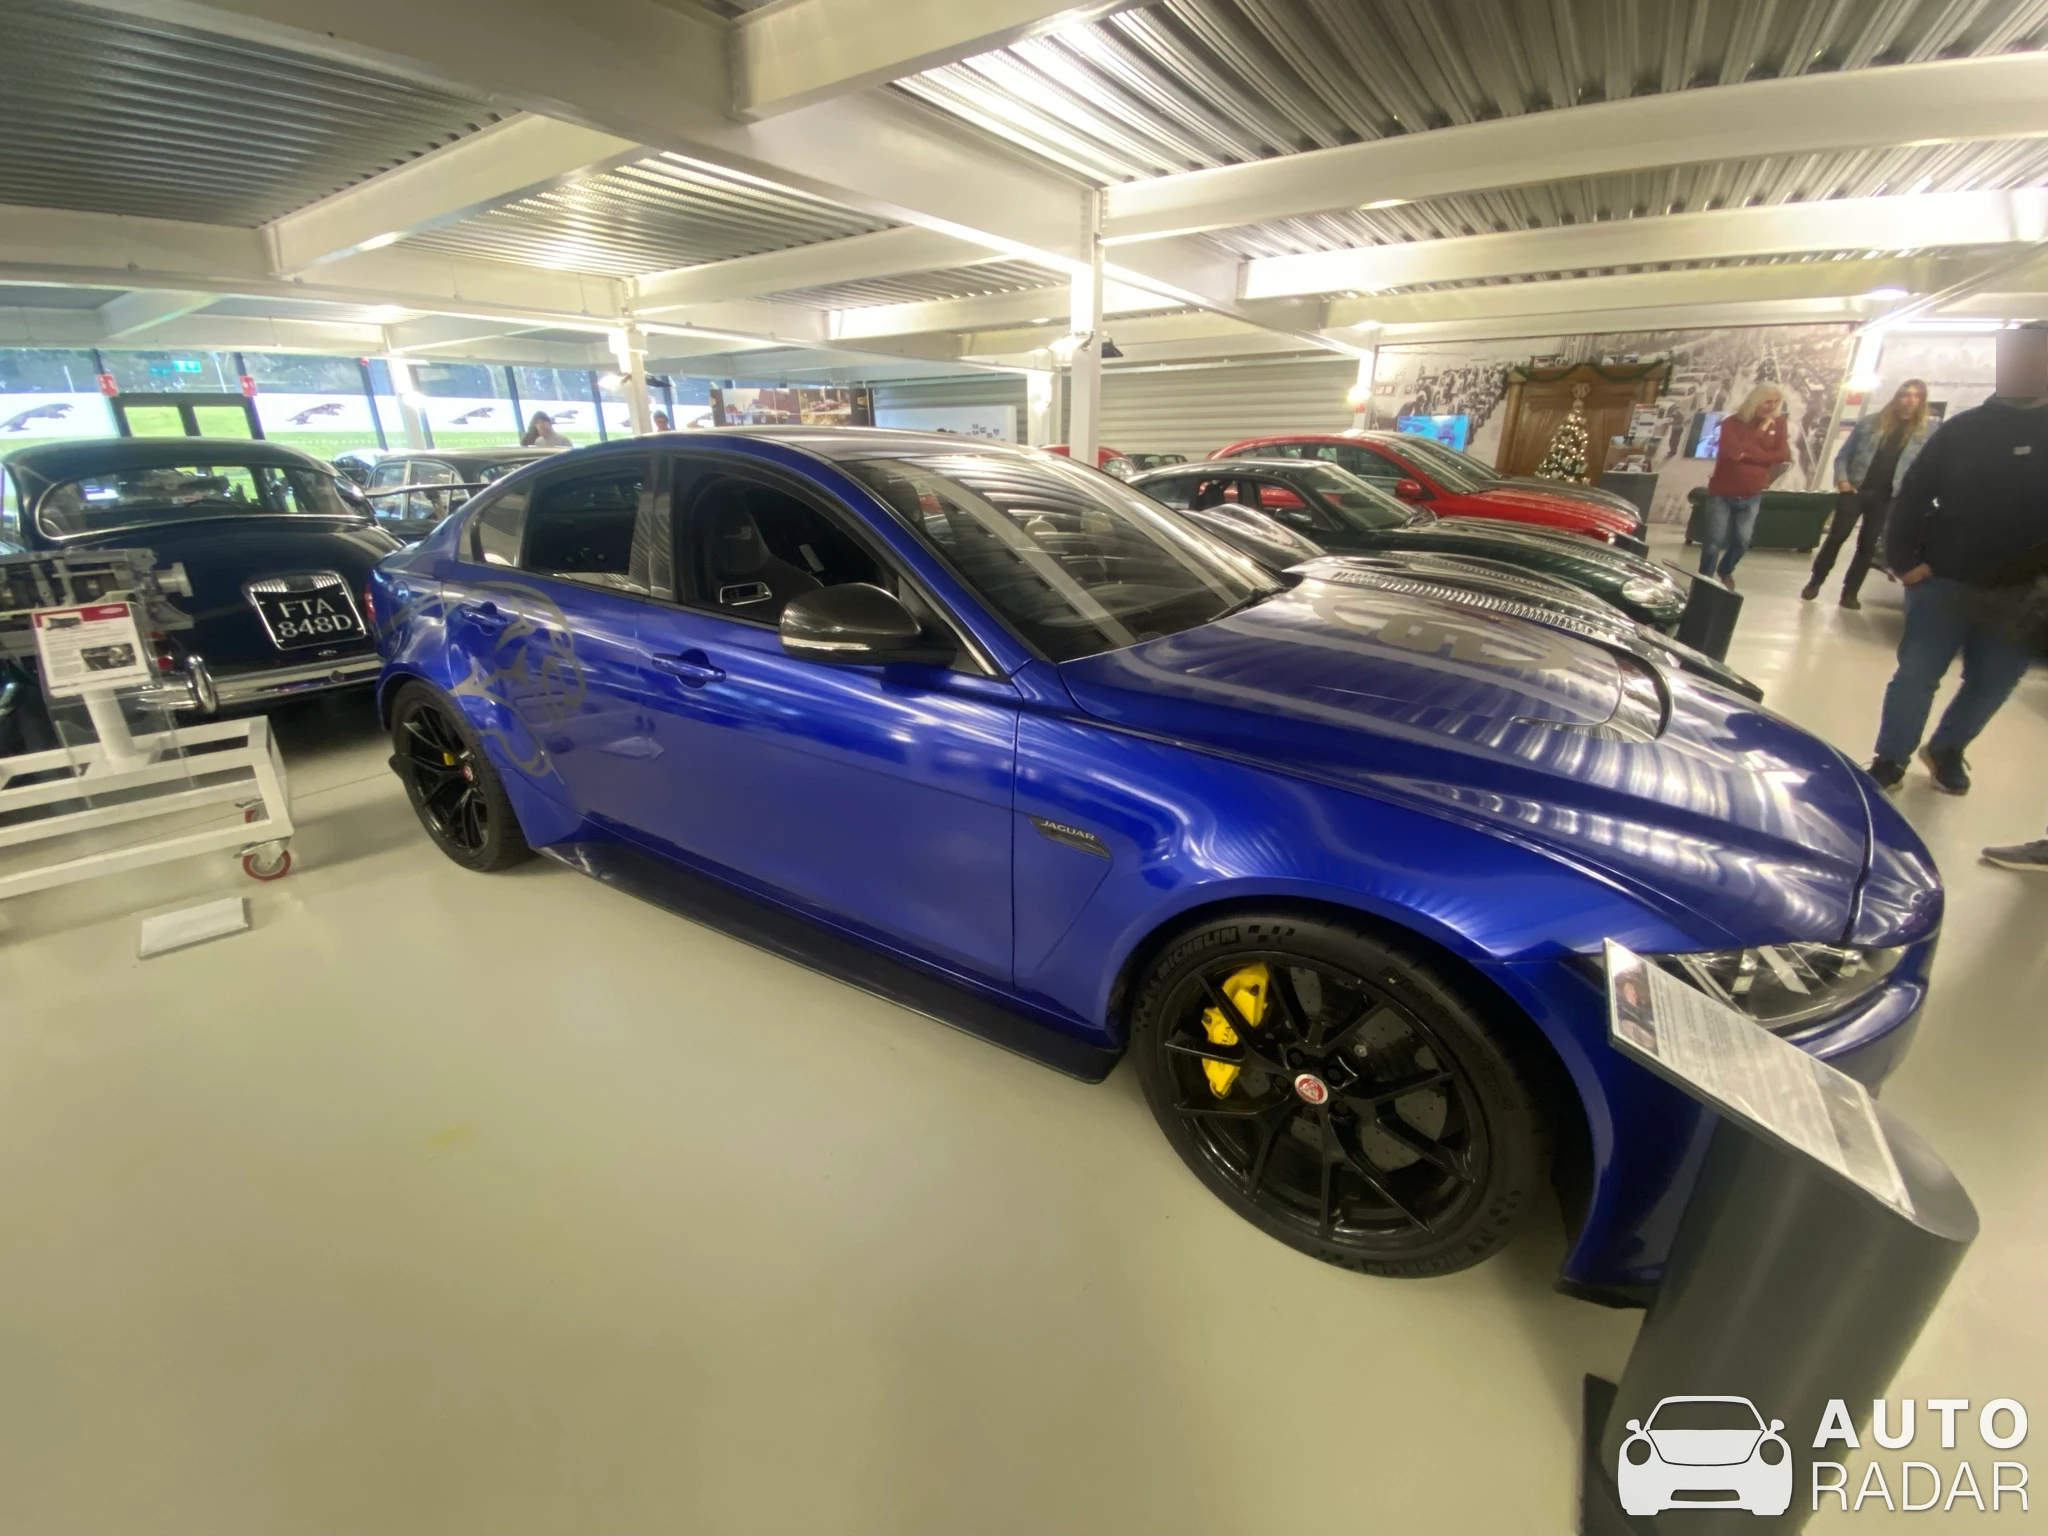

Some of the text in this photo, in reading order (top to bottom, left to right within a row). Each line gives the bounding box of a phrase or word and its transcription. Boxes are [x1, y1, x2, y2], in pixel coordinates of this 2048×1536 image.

[279, 598, 335, 618] FTA
[278, 614, 352, 638] 848D
[1040, 820, 1095, 841] JAGUAR
[1157, 926, 1239, 981] MICHELIN
